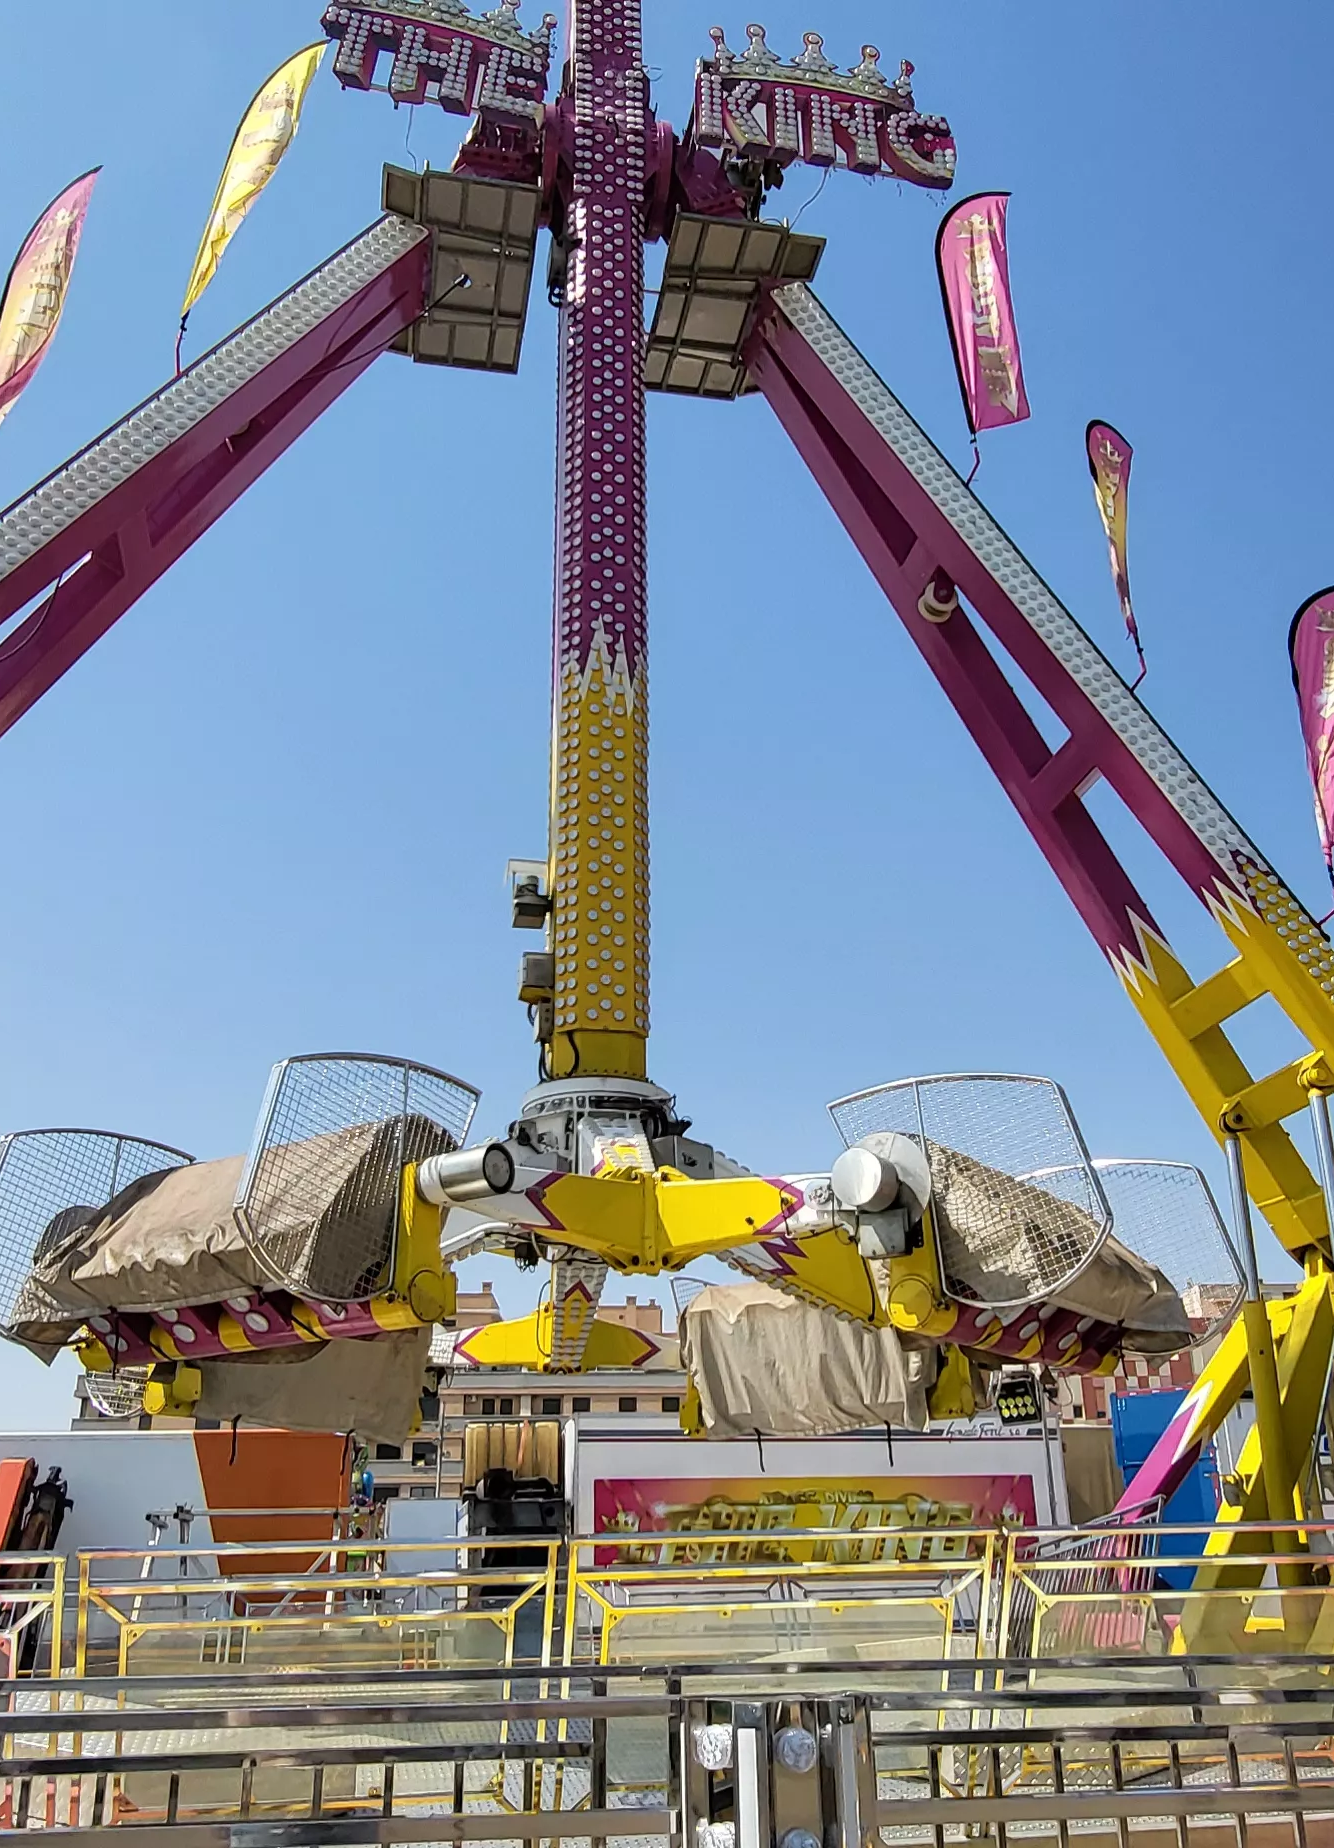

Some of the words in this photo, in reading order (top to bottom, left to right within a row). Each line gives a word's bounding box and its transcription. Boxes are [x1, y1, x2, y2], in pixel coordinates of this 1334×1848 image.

[323, 5, 545, 120] THE
[698, 72, 956, 187] KING
[811, 1502, 975, 1564] KING
